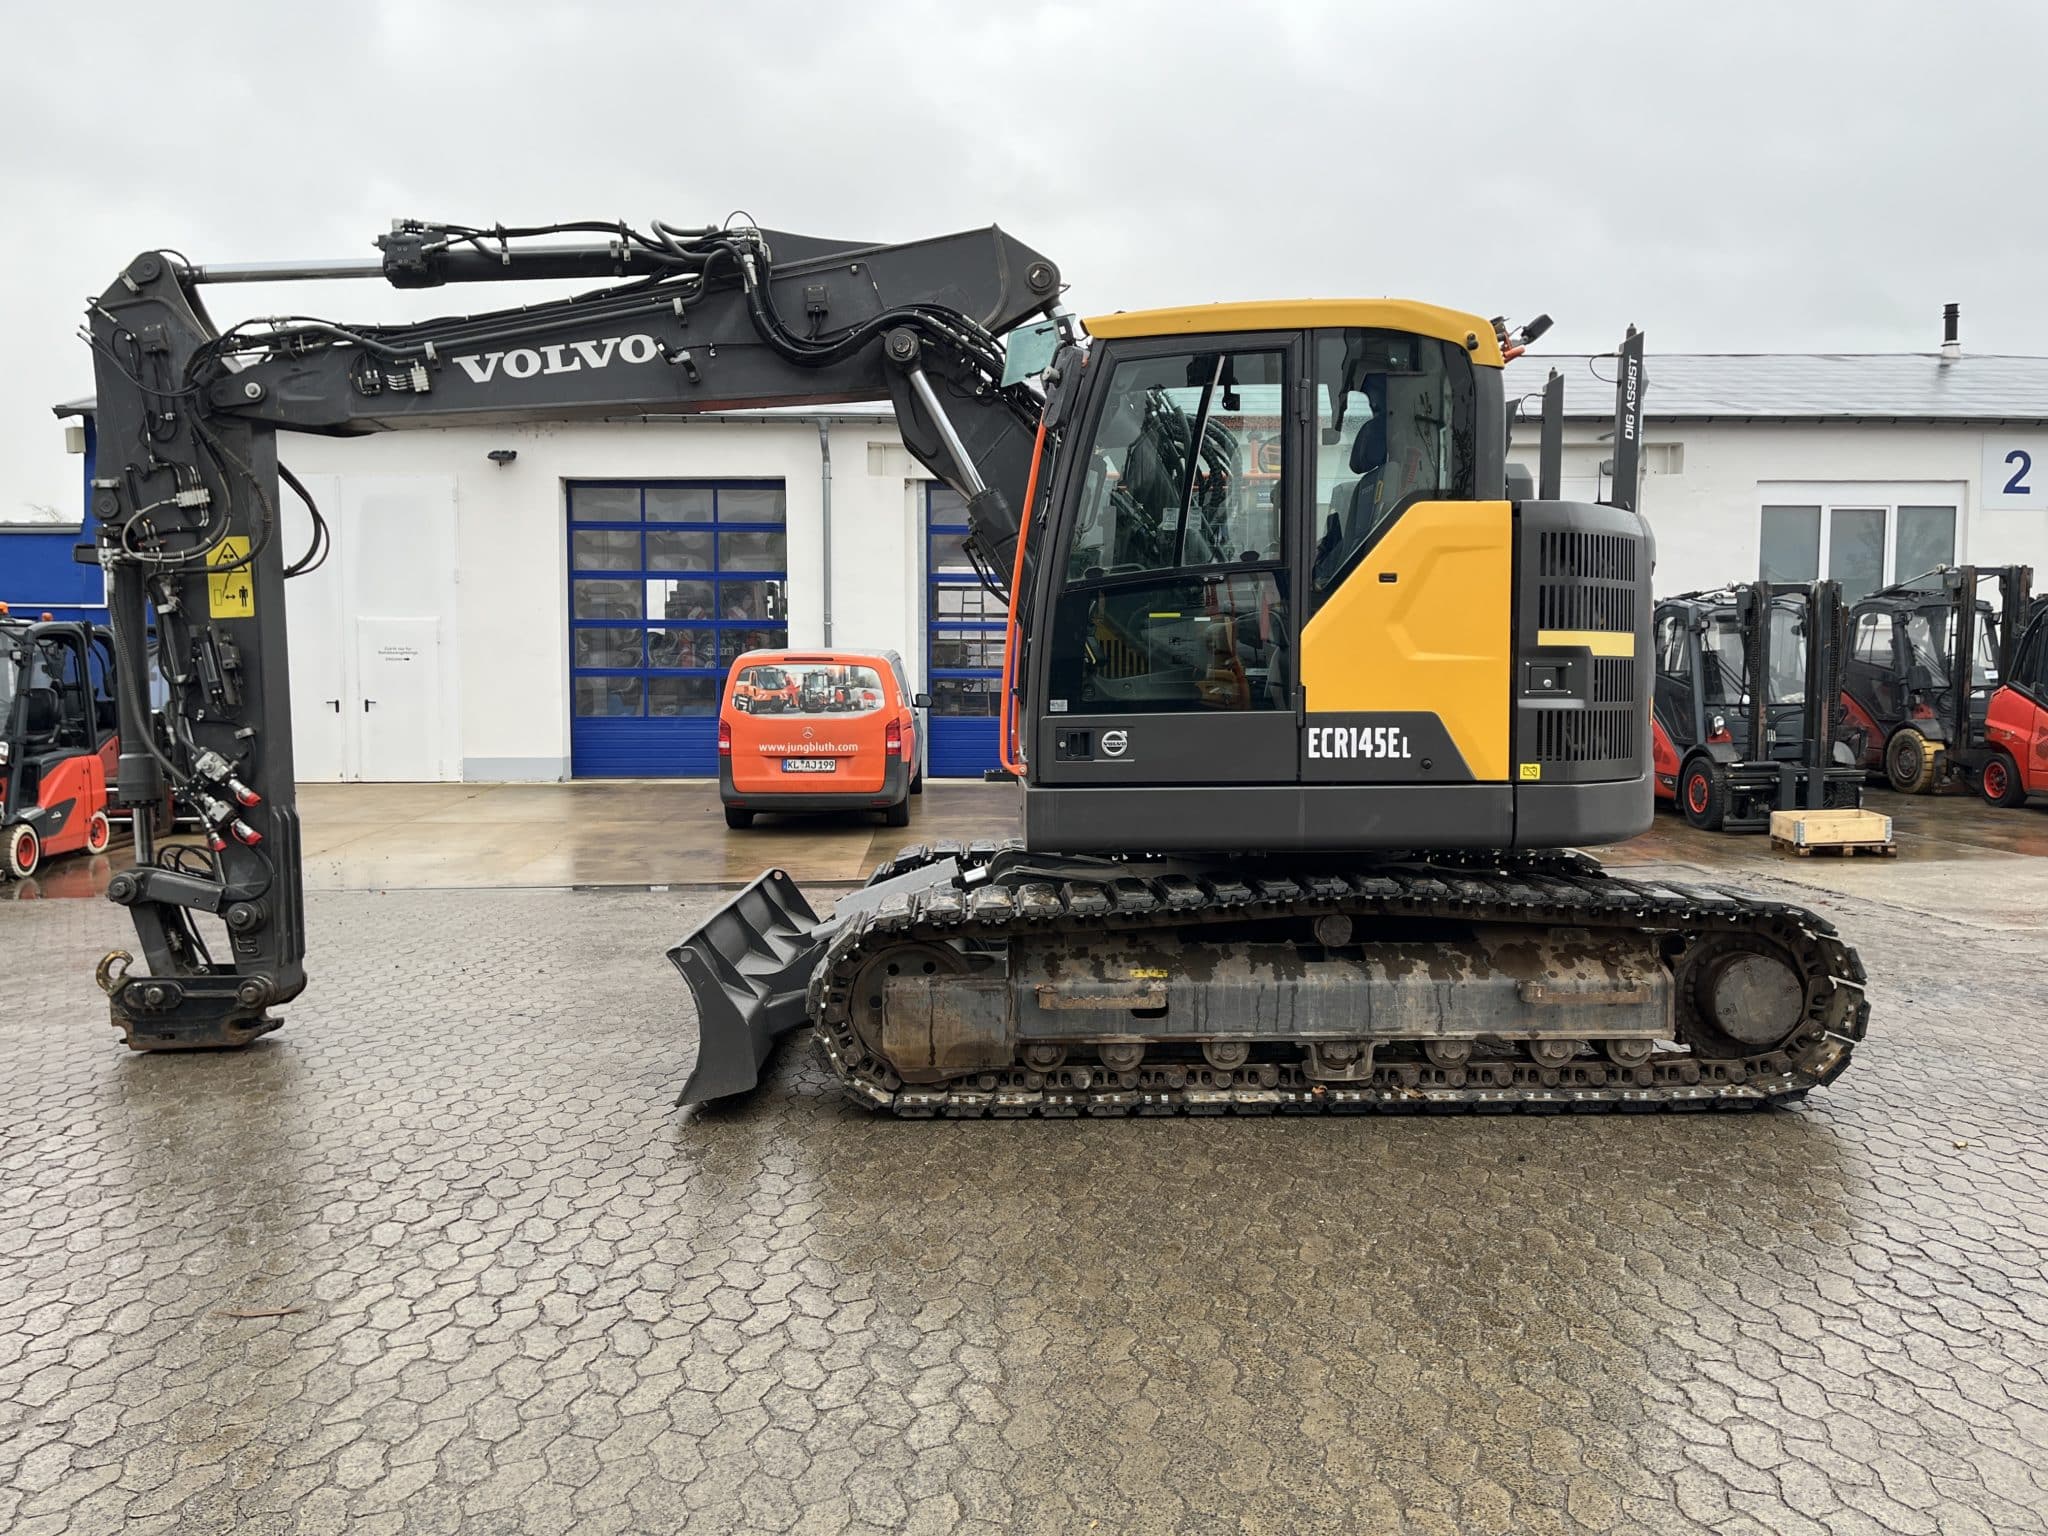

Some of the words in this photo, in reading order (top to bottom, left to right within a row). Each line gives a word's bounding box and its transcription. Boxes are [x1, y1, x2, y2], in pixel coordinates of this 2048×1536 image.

[452, 334, 657, 383] VOLVO
[1626, 355, 1638, 412] ASSIST
[1624, 414, 1635, 440] DIG
[2003, 449, 2031, 494] 2
[759, 742, 858, 753] www.jungbluth.com
